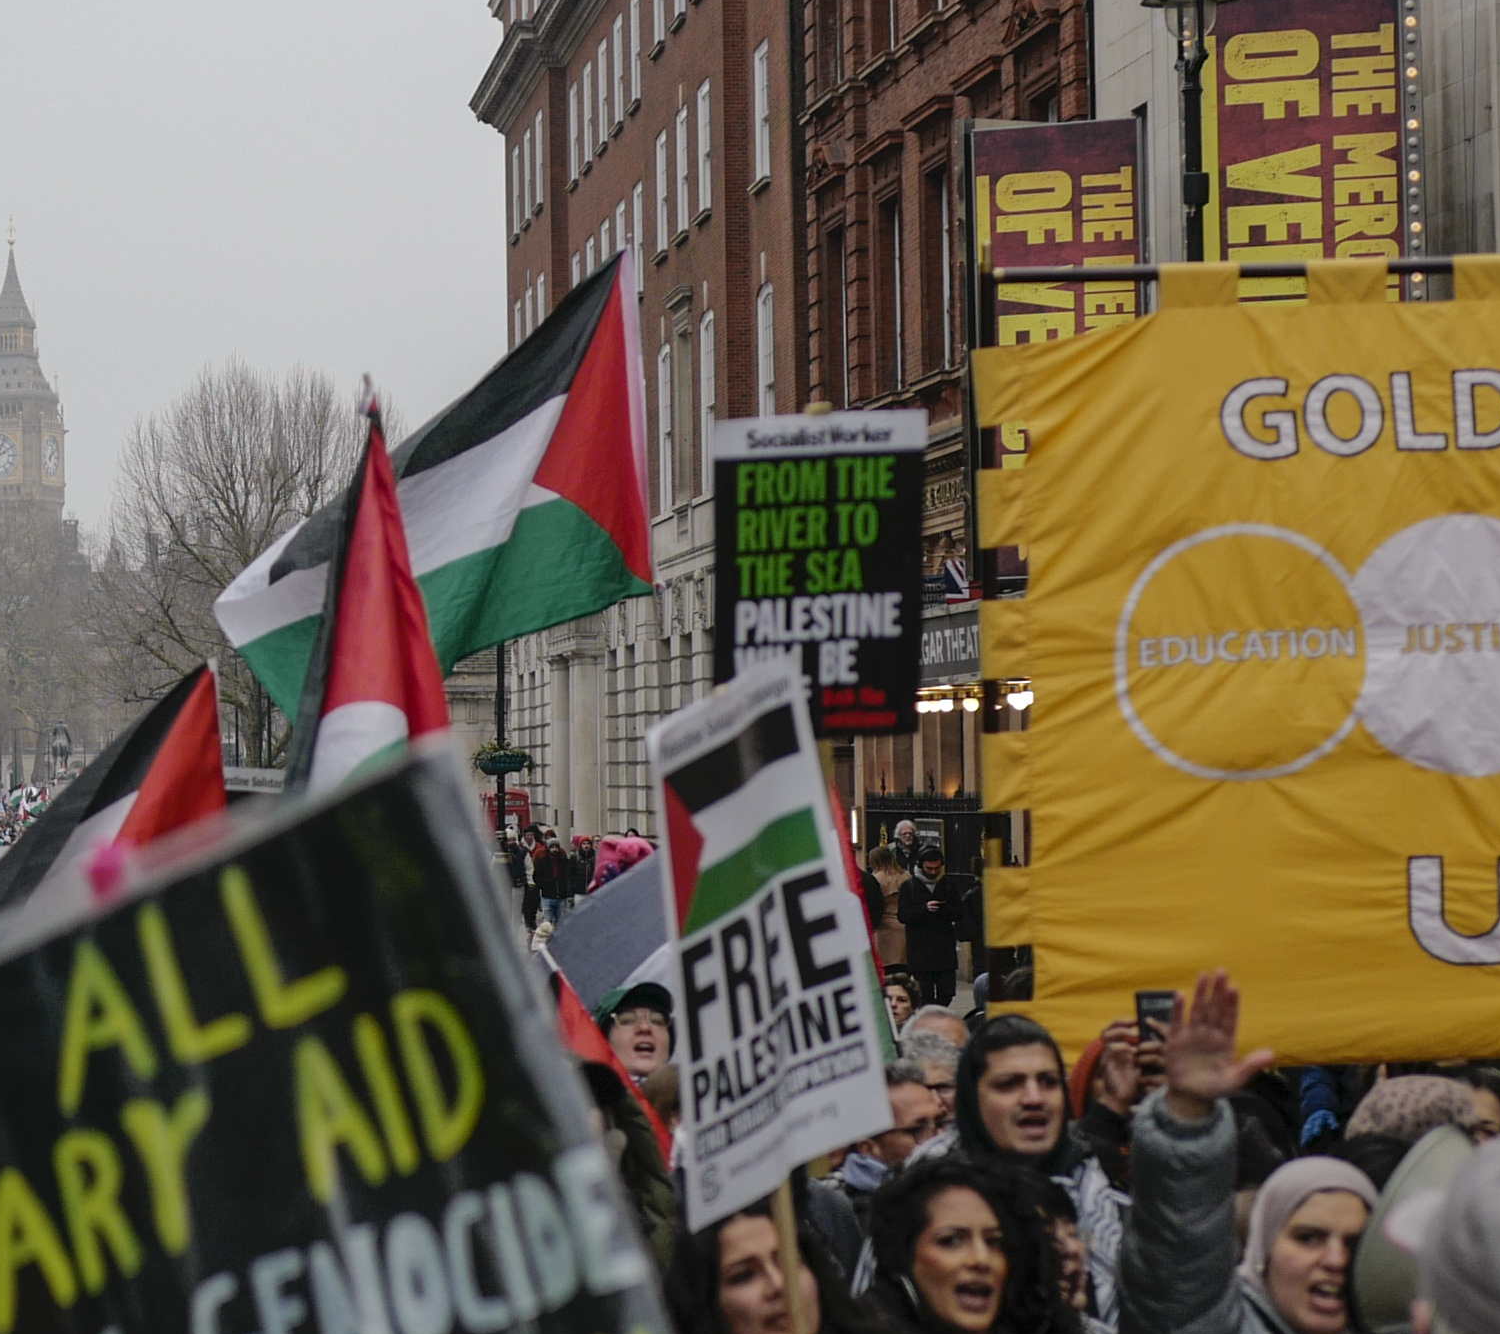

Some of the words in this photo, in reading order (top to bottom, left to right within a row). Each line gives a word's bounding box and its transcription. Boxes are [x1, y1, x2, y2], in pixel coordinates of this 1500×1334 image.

[1223, 28, 1321, 120] OF
[1331, 23, 1397, 118] THE
[995, 170, 1074, 245] OF
[1080, 165, 1135, 244] THE
[736, 461, 828, 507] FROM
[833, 455, 898, 500] THE
[736, 506, 828, 553] RIVER
[833, 502, 880, 547] TO
[735, 552, 796, 598] THE
[805, 549, 864, 595] SEA
[734, 591, 903, 646] PALESTINE
[921, 636, 943, 666] GAR
[944, 630, 980, 663] THEAT
[1137, 626, 1357, 668] EDUCATION
[818, 638, 859, 686] BE
[57, 869, 348, 1117] ALL
[681, 868, 851, 1063] FREE
[692, 985, 863, 1124] PALESTINE
[294, 989, 485, 1204] AID
